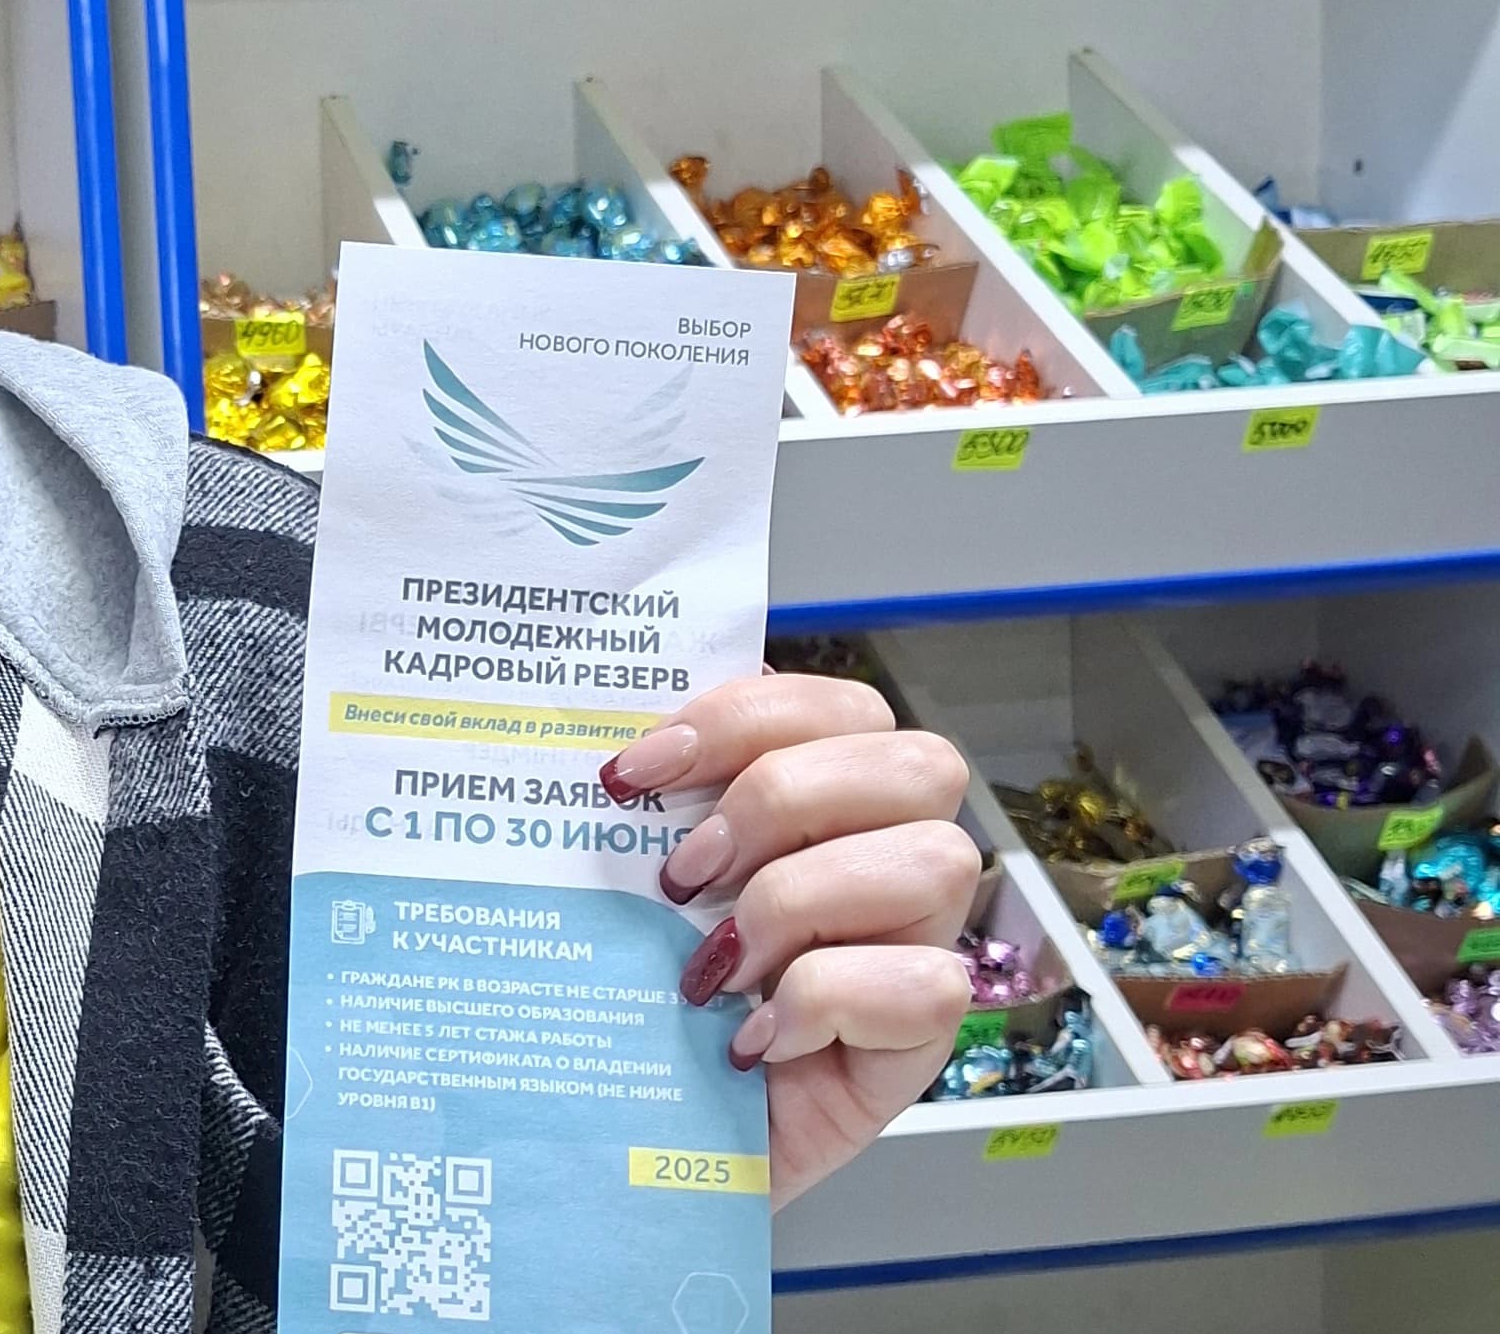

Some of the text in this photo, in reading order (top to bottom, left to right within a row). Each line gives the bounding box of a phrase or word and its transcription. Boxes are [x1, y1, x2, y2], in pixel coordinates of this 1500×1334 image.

[242, 320, 300, 347] 4960
[678, 317, 752, 339] ВЫБОР
[519, 332, 750, 366] НОВОГО ПОКОЛЕНИЯ
[402, 576, 680, 619] ПРЕЗИДЕНТСКИЙ
[416, 615, 661, 654] МОЛОДЕЖНЫЙ
[384, 649, 690, 693] КАДРОВЫЙ РЕЗЕРВ
[344, 704, 406, 725] Внеси
[409, 707, 457, 729] свой
[460, 711, 521, 736] вклад
[525, 721, 536, 733] в
[539, 722, 636, 741] развитие
[394, 769, 515, 803] ПРИЕМ
[364, 806, 394, 838] С
[404, 810, 422, 839] 1
[433, 811, 496, 844] ПО
[506, 818, 553, 849] 30
[394, 901, 562, 931] ТРЕБОВАНИЯ
[392, 931, 594, 963] К УЧАСТНИКАМ
[341, 971, 436, 992] ГРАЖДАНЕ
[438, 976, 461, 992] РК
[463, 978, 475, 993] В
[476, 979, 565, 998] ВОЗРАСТЕ
[566, 984, 590, 999] НЕ
[592, 985, 666, 1004] СТАРШЕ
[340, 994, 645, 1026] НАЛИЧИЕ ВЫСШЕГО ОБРАЗОВАНИЯ
[339, 1018, 612, 1050] НЕ МЕНЕЕ 5 ЛЕТ СТАЖА РАБОТЫ
[339, 1042, 672, 1078] НАЛИЧИЕ СЕРТИФИКАТА О ВЛАДЕНИИ
[337, 1091, 408, 1110] УРОВНЯ
[338, 1067, 683, 1102] ГОСУДАРСТВЕННЫМ ЯЗЫКОМ (НЕ НИЖЕ
[654, 1155, 731, 1184] 2025
